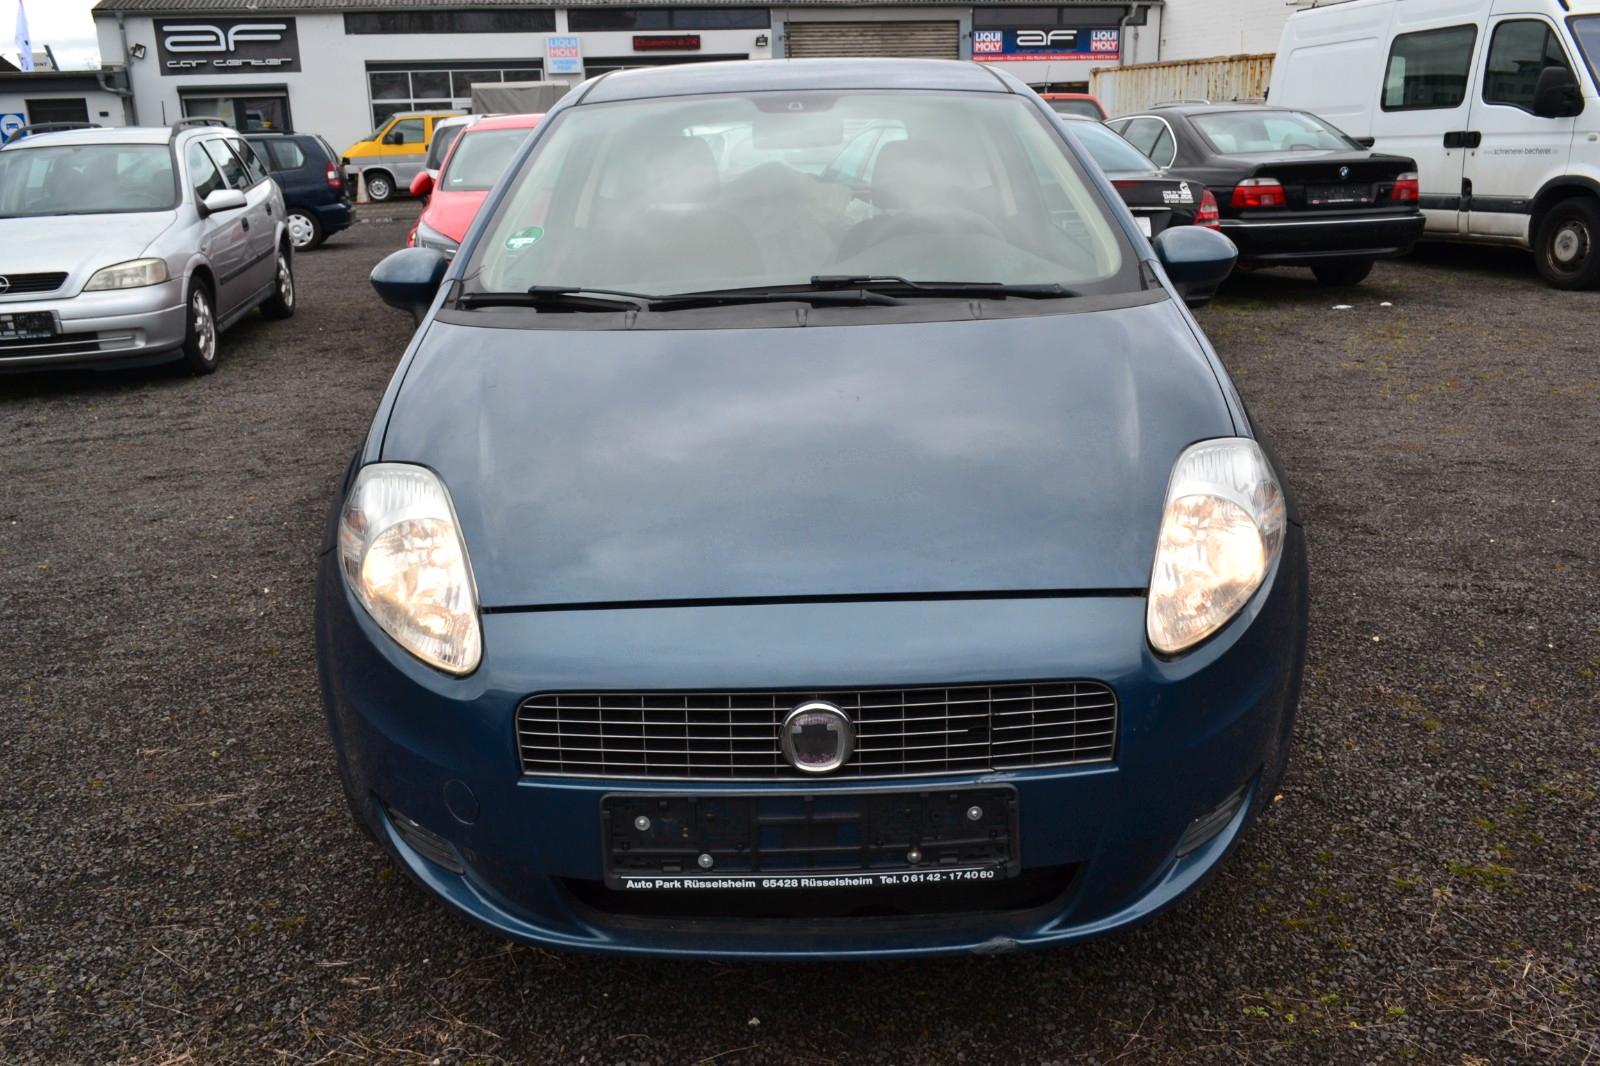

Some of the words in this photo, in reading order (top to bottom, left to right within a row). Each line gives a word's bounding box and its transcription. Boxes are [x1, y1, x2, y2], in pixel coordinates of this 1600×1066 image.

[975, 32, 1001, 41] LIQUI
[1092, 31, 1117, 41] LIQUI
[549, 38, 578, 48] LIQUI
[975, 42, 1001, 51] MOLY
[1092, 41, 1117, 51] MOLY
[549, 48, 578, 57] MOLY
[213, 58, 292, 67] center
[626, 879, 653, 889] Auto
[655, 879, 682, 889] Park
[684, 879, 756, 888] Rüsselsheim
[762, 879, 798, 888] 65428
[801, 877, 873, 888] Rüsselsheim
[880, 875, 900, 884] Tel.
